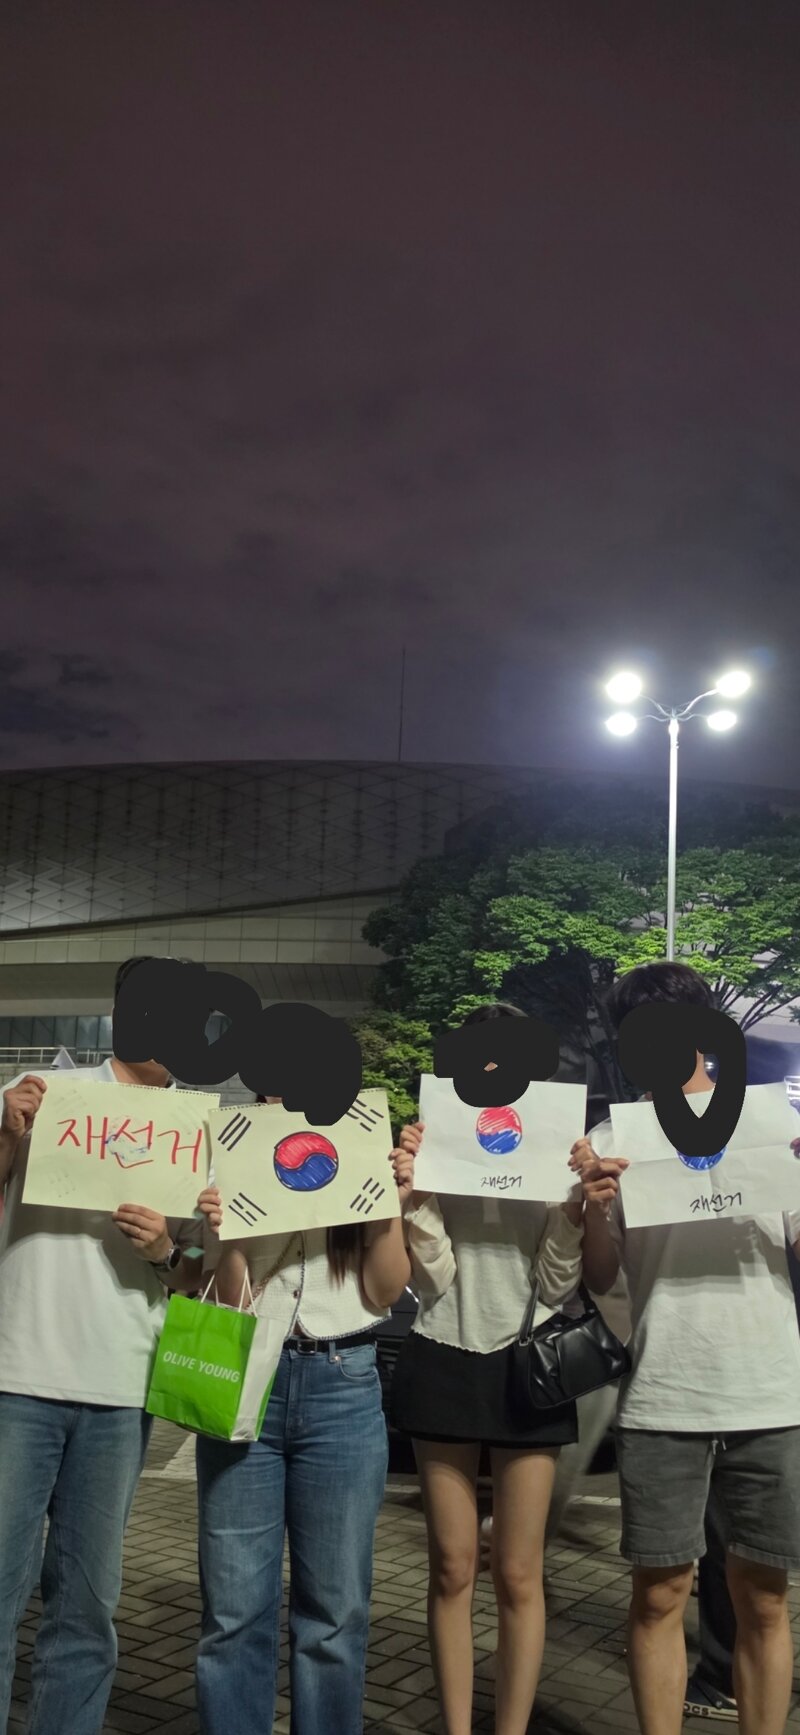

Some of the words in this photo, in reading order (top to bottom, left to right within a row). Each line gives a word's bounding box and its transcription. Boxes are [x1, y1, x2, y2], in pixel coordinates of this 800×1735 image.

[57, 1115, 202, 1173] 재선거
[480, 1175, 522, 1190] 재선거
[689, 1191, 742, 1213] 재선거
[163, 1350, 197, 1370] OLIVE
[198, 1360, 240, 1383] YOUNG
